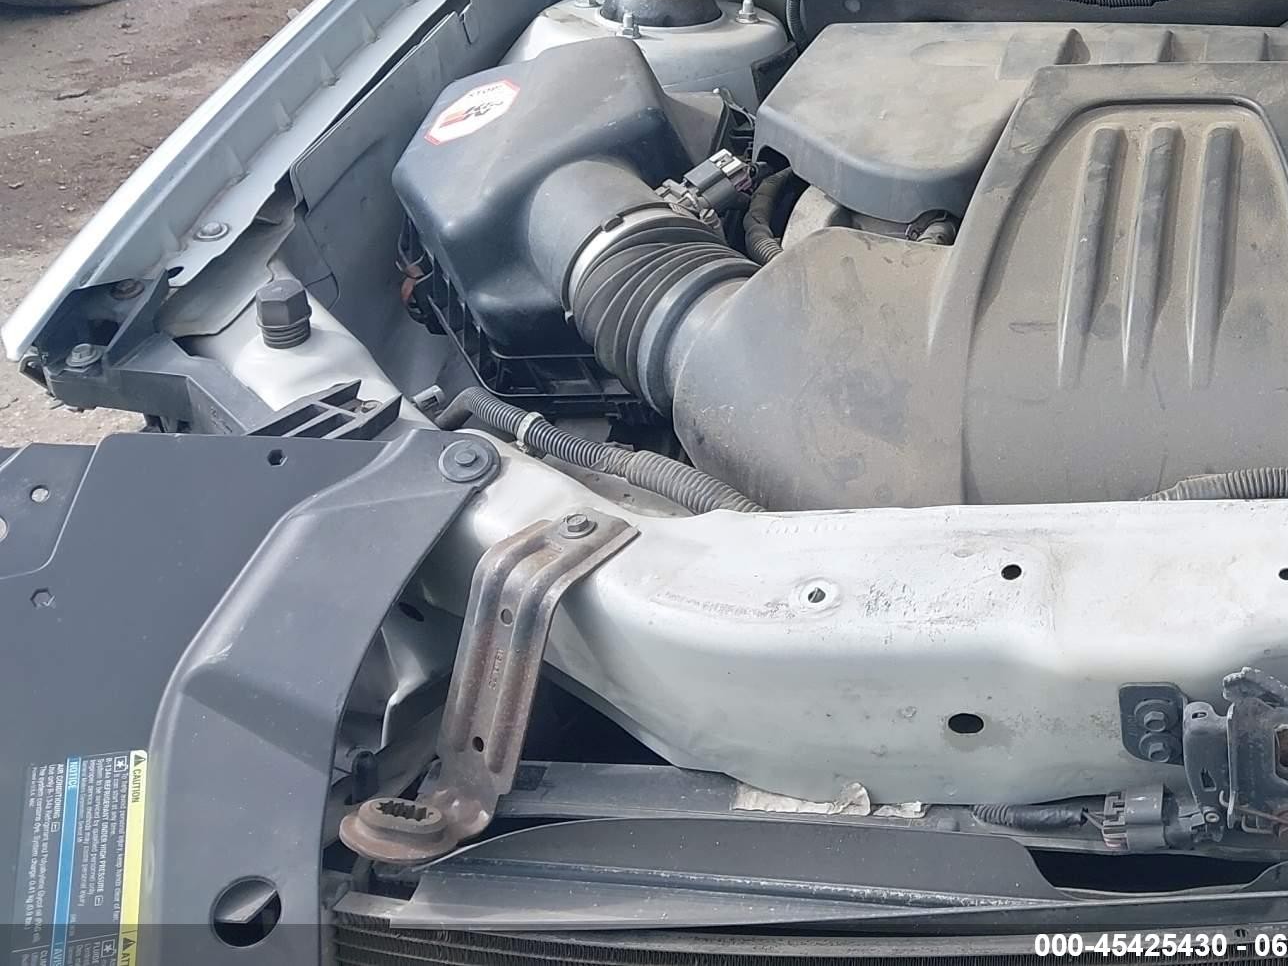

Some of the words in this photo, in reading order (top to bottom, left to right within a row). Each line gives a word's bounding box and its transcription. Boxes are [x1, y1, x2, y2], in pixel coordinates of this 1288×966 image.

[67, 761, 77, 789] NOTICE
[131, 768, 141, 803] CAUTION
[53, 775, 63, 818] CONDITIONING
[101, 779, 110, 820] REFRIGERANT
[96, 860, 105, 892] PRESSURE
